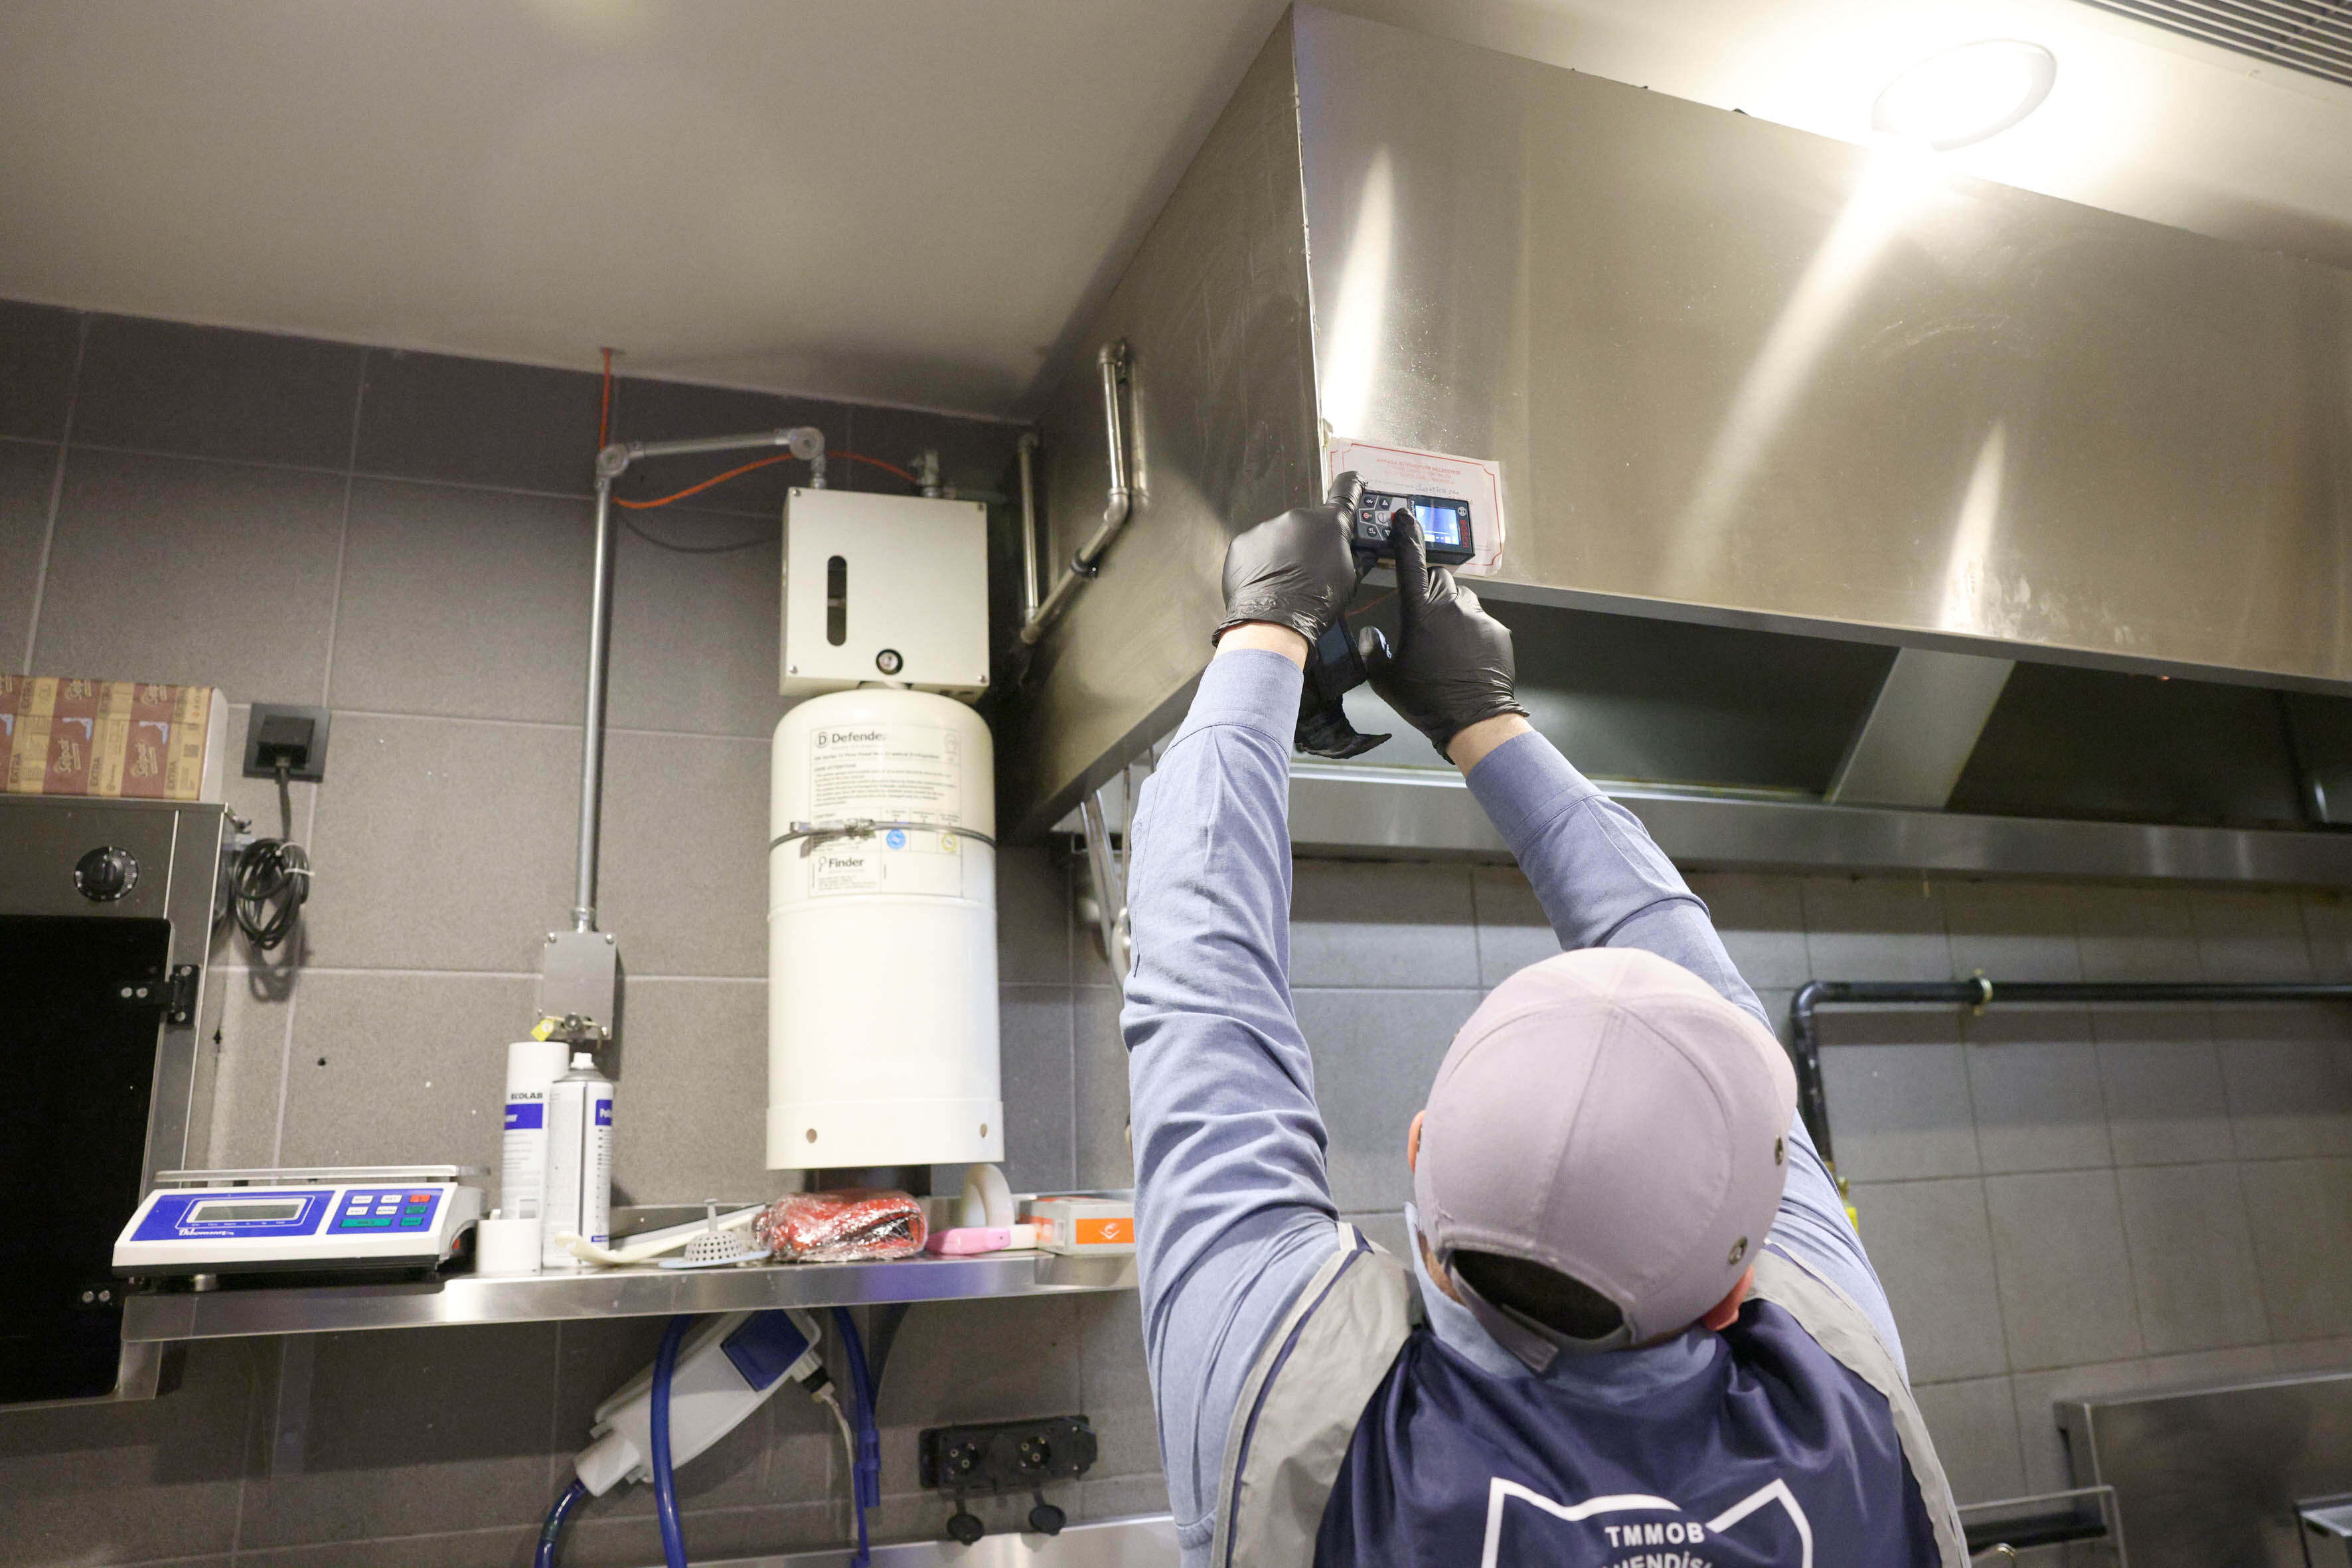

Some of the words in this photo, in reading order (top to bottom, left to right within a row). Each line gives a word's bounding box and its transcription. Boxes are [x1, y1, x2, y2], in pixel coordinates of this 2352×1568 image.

[1460, 519, 1469, 548] BOSCH
[832, 730, 886, 744] Defende
[10, 753, 21, 783] EXTRA
[90, 757, 101, 787] EXTRA
[167, 761, 177, 790] EXTRA
[828, 857, 864, 868] Finder
[1604, 1522, 1705, 1548] TMMOB
